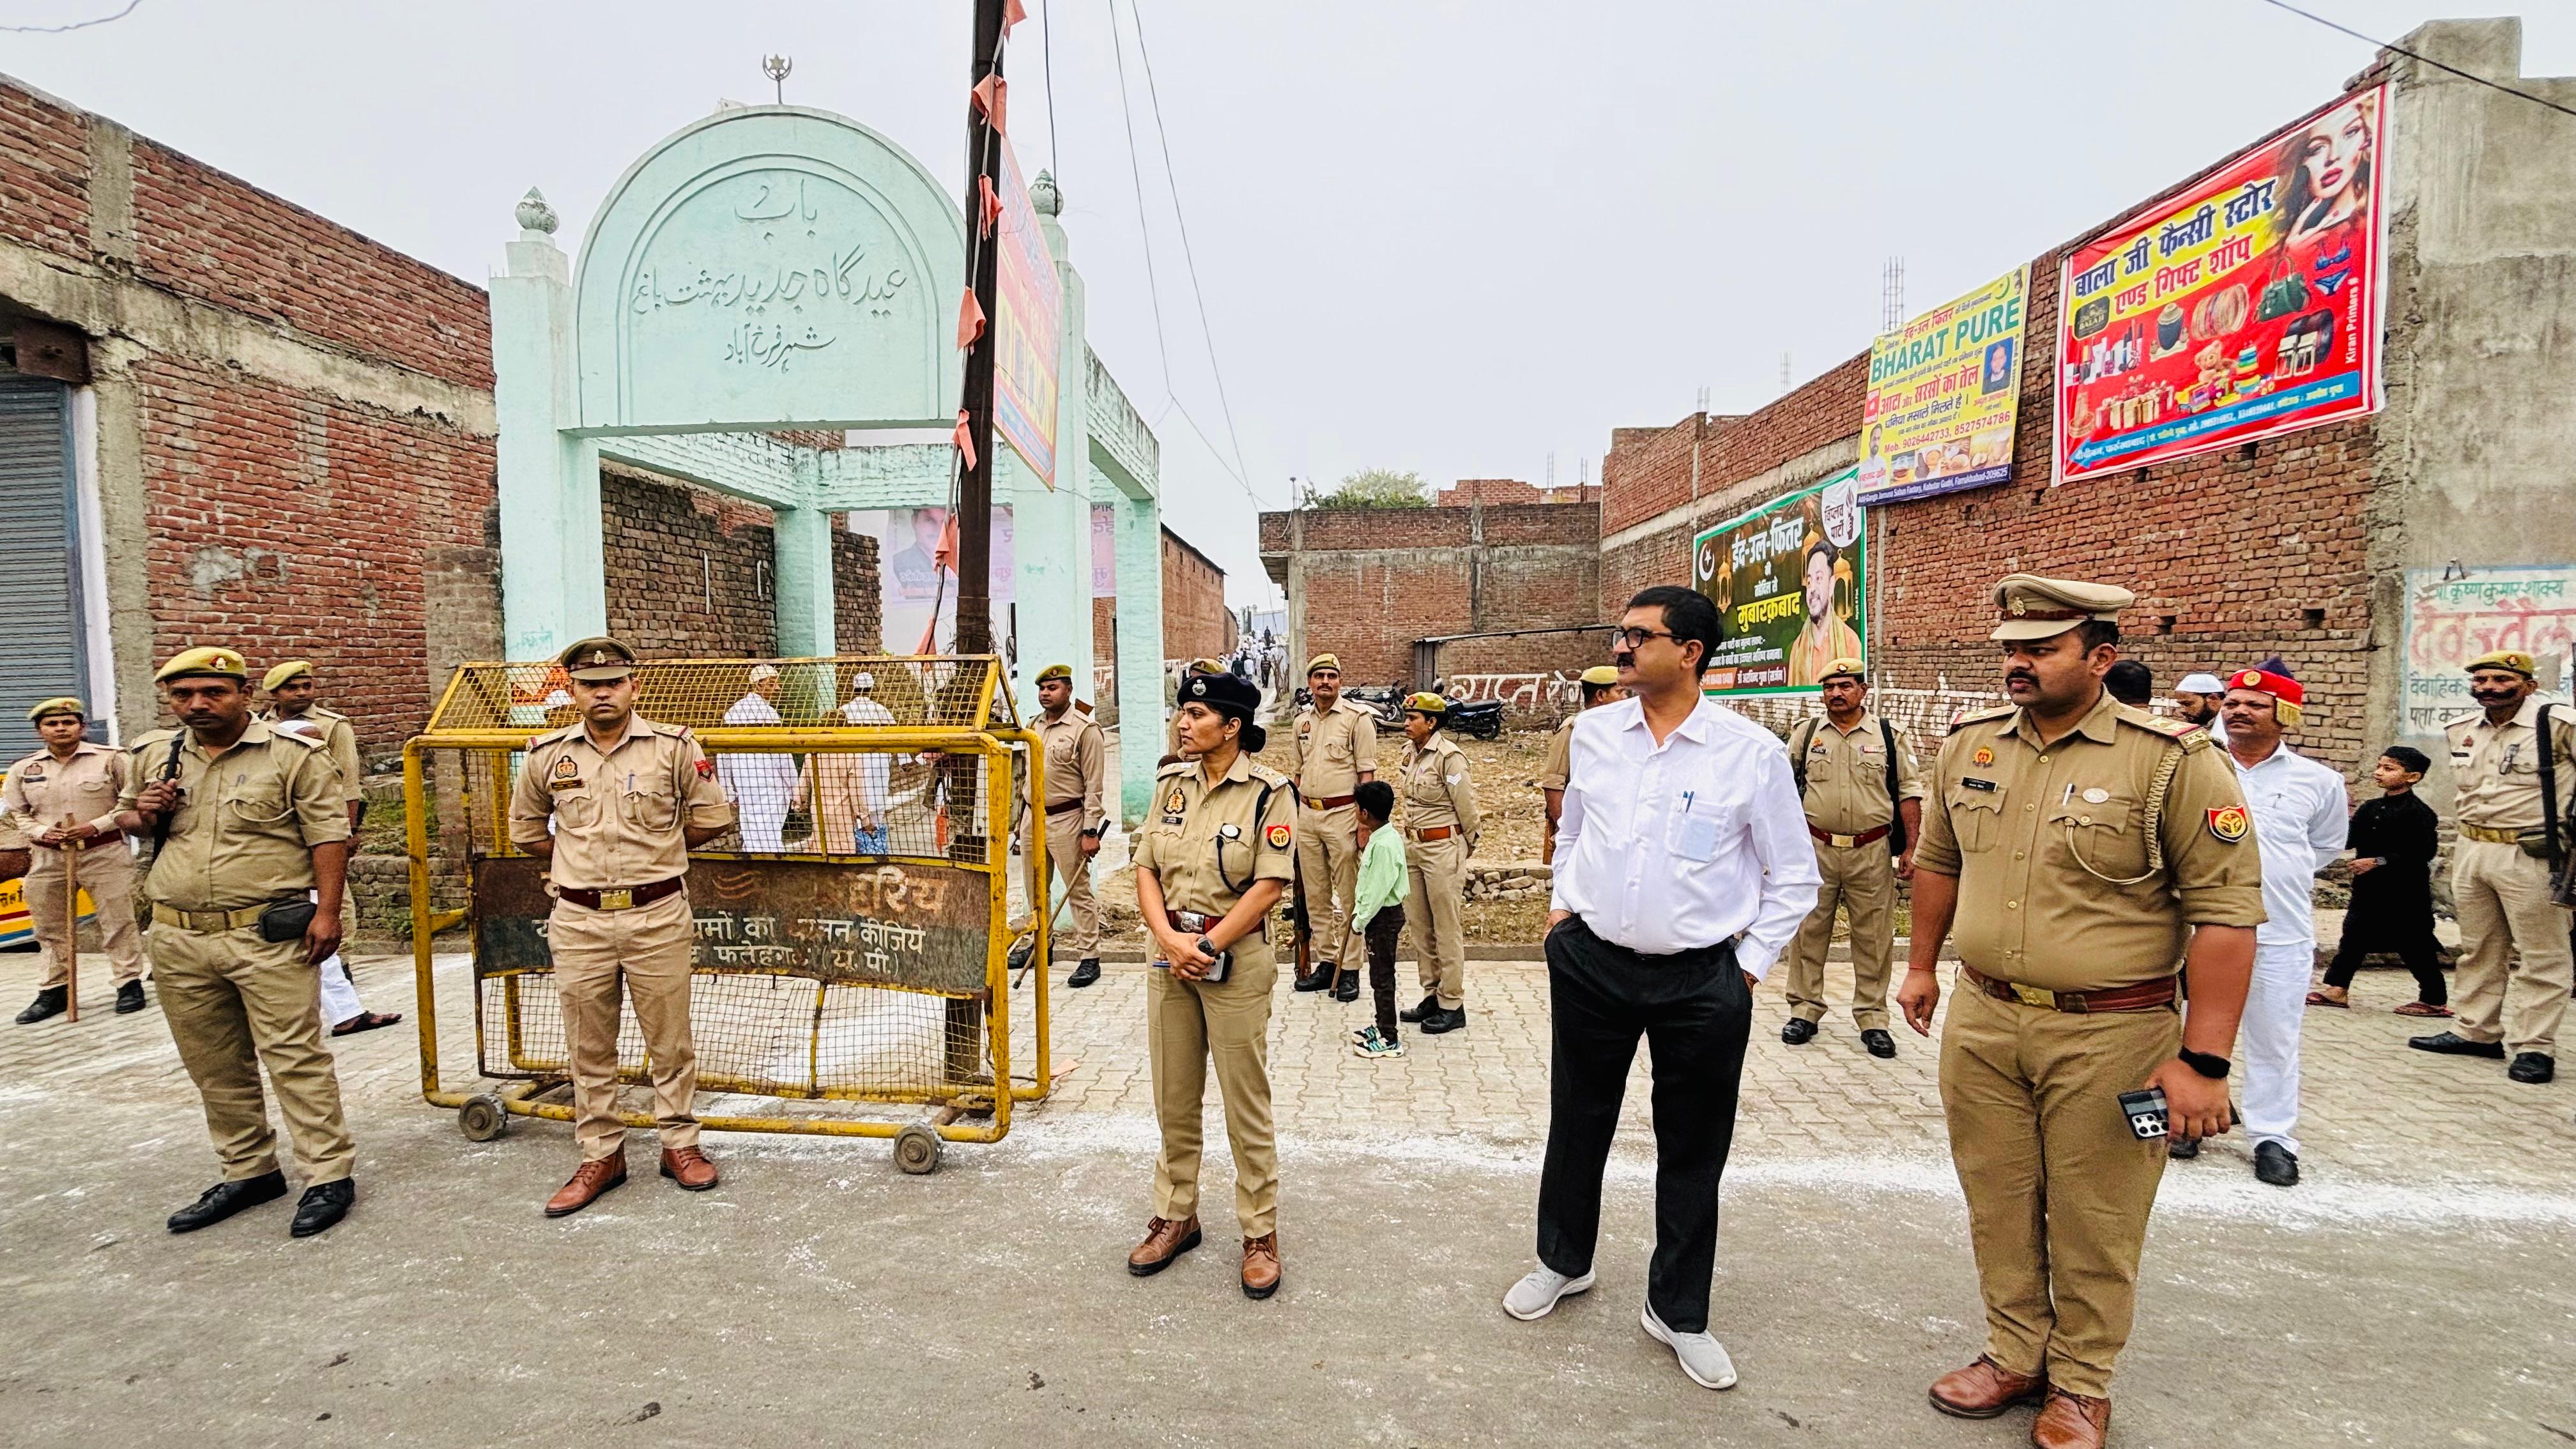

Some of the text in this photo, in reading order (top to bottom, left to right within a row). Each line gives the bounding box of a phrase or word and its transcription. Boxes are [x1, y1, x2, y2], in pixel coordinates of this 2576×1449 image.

[2074, 257, 2117, 297] बाला
[2123, 236, 2152, 275] जी
[2224, 179, 2276, 228] स्टोर
[631, 266, 662, 315] باغ
[2115, 234, 2253, 314] एण्ड गिफ्ट शॉप
[1871, 327, 1949, 383] BHARAT
[1954, 296, 2021, 350] PURE
[2345, 286, 2358, 364] Kiran Printers
[1880, 392, 1902, 415] आटा
[1915, 372, 1942, 404] सरसों
[1942, 371, 1958, 394] का
[1959, 364, 1981, 389] तेल
[1906, 403, 1929, 422] मसाले
[1931, 395, 1953, 415] मिलते
[1884, 441, 1900, 453] Mob.
[1955, 411, 2010, 435] 8527574786
[743, 916, 776, 939] का
[859, 917, 926, 954] कीजिये
